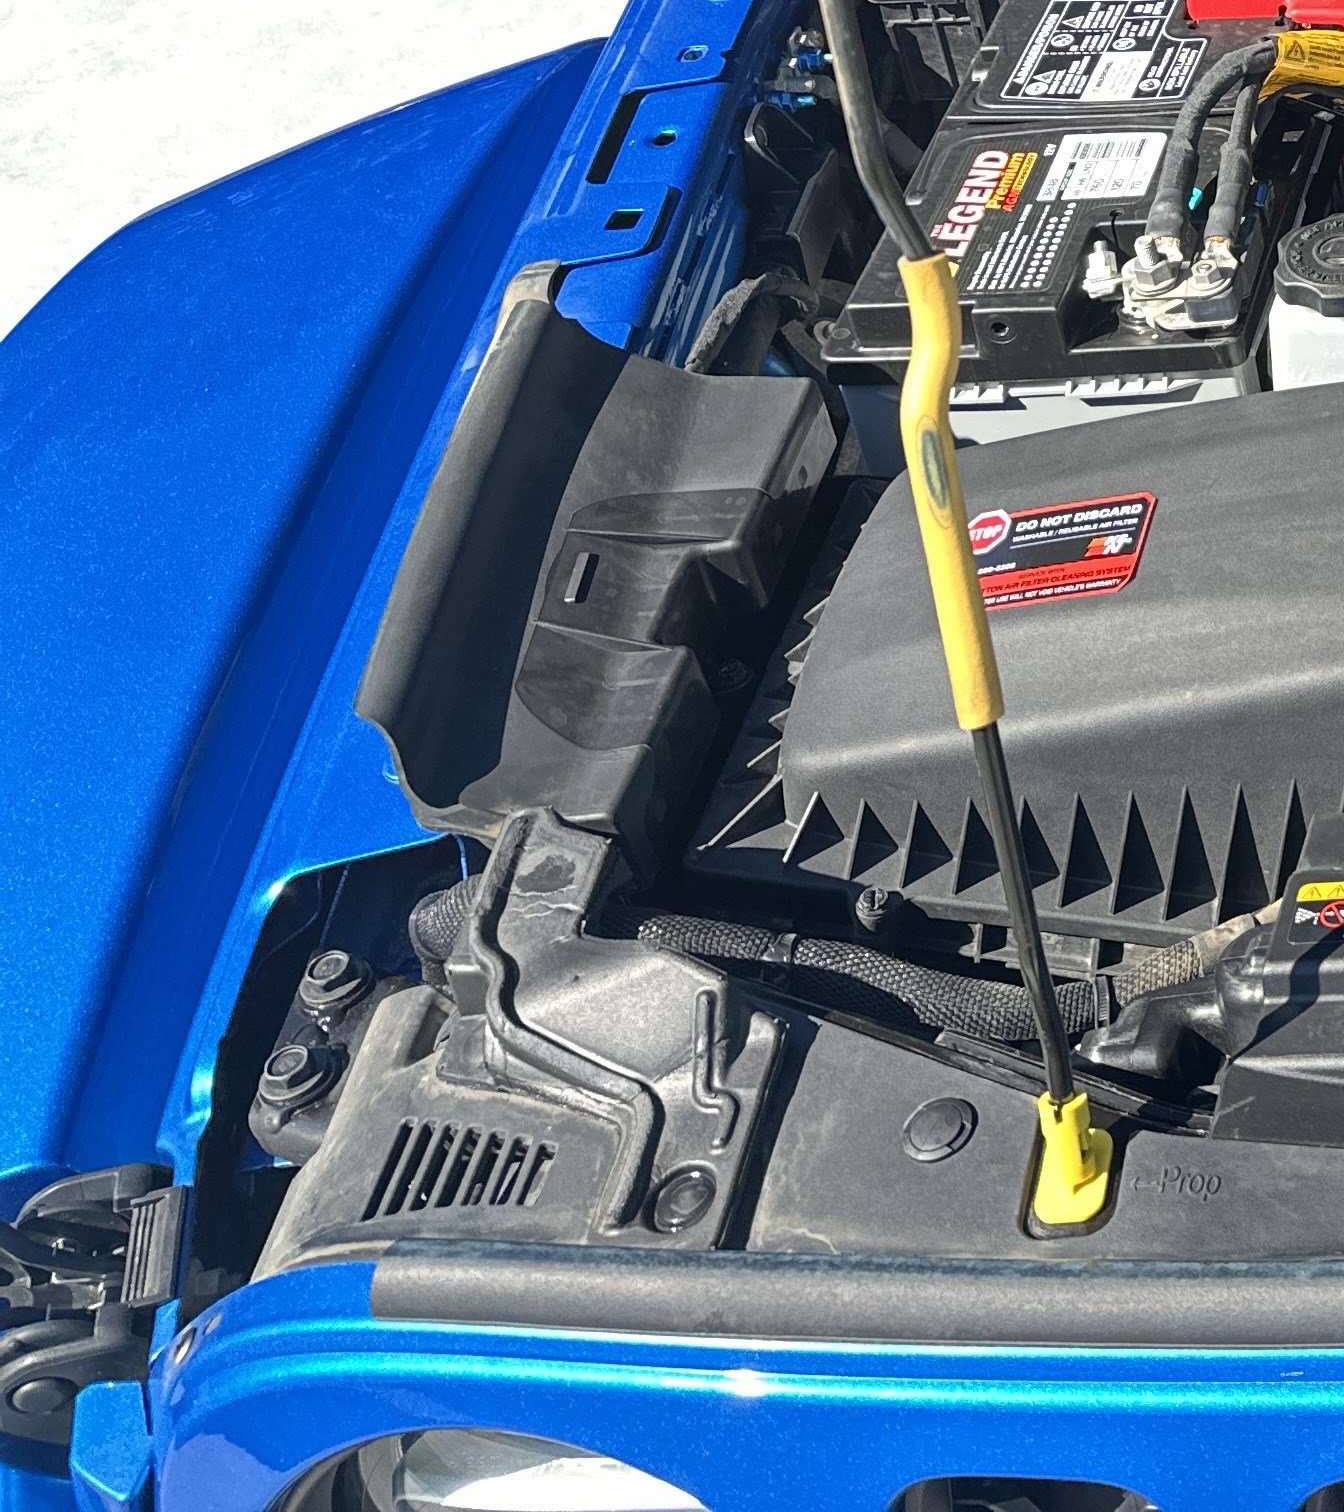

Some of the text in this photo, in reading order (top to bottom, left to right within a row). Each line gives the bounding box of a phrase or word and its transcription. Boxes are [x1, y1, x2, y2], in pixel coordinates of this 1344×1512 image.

[985, 153, 1025, 210] Premium
[942, 150, 1010, 258] LEGEND
[1015, 504, 1143, 532] DO NOT DISCARD
[1058, 523, 1098, 535] REUSABLE
[1098, 521, 1112, 529] AIR
[1112, 518, 1139, 527] FILTER
[1005, 582, 1019, 590] AIR
[1021, 578, 1049, 587] FILTER
[1050, 570, 1094, 583] CLEANING
[1096, 564, 1132, 576] SYSTEM
[1161, 1165, 1222, 1202] Prop
